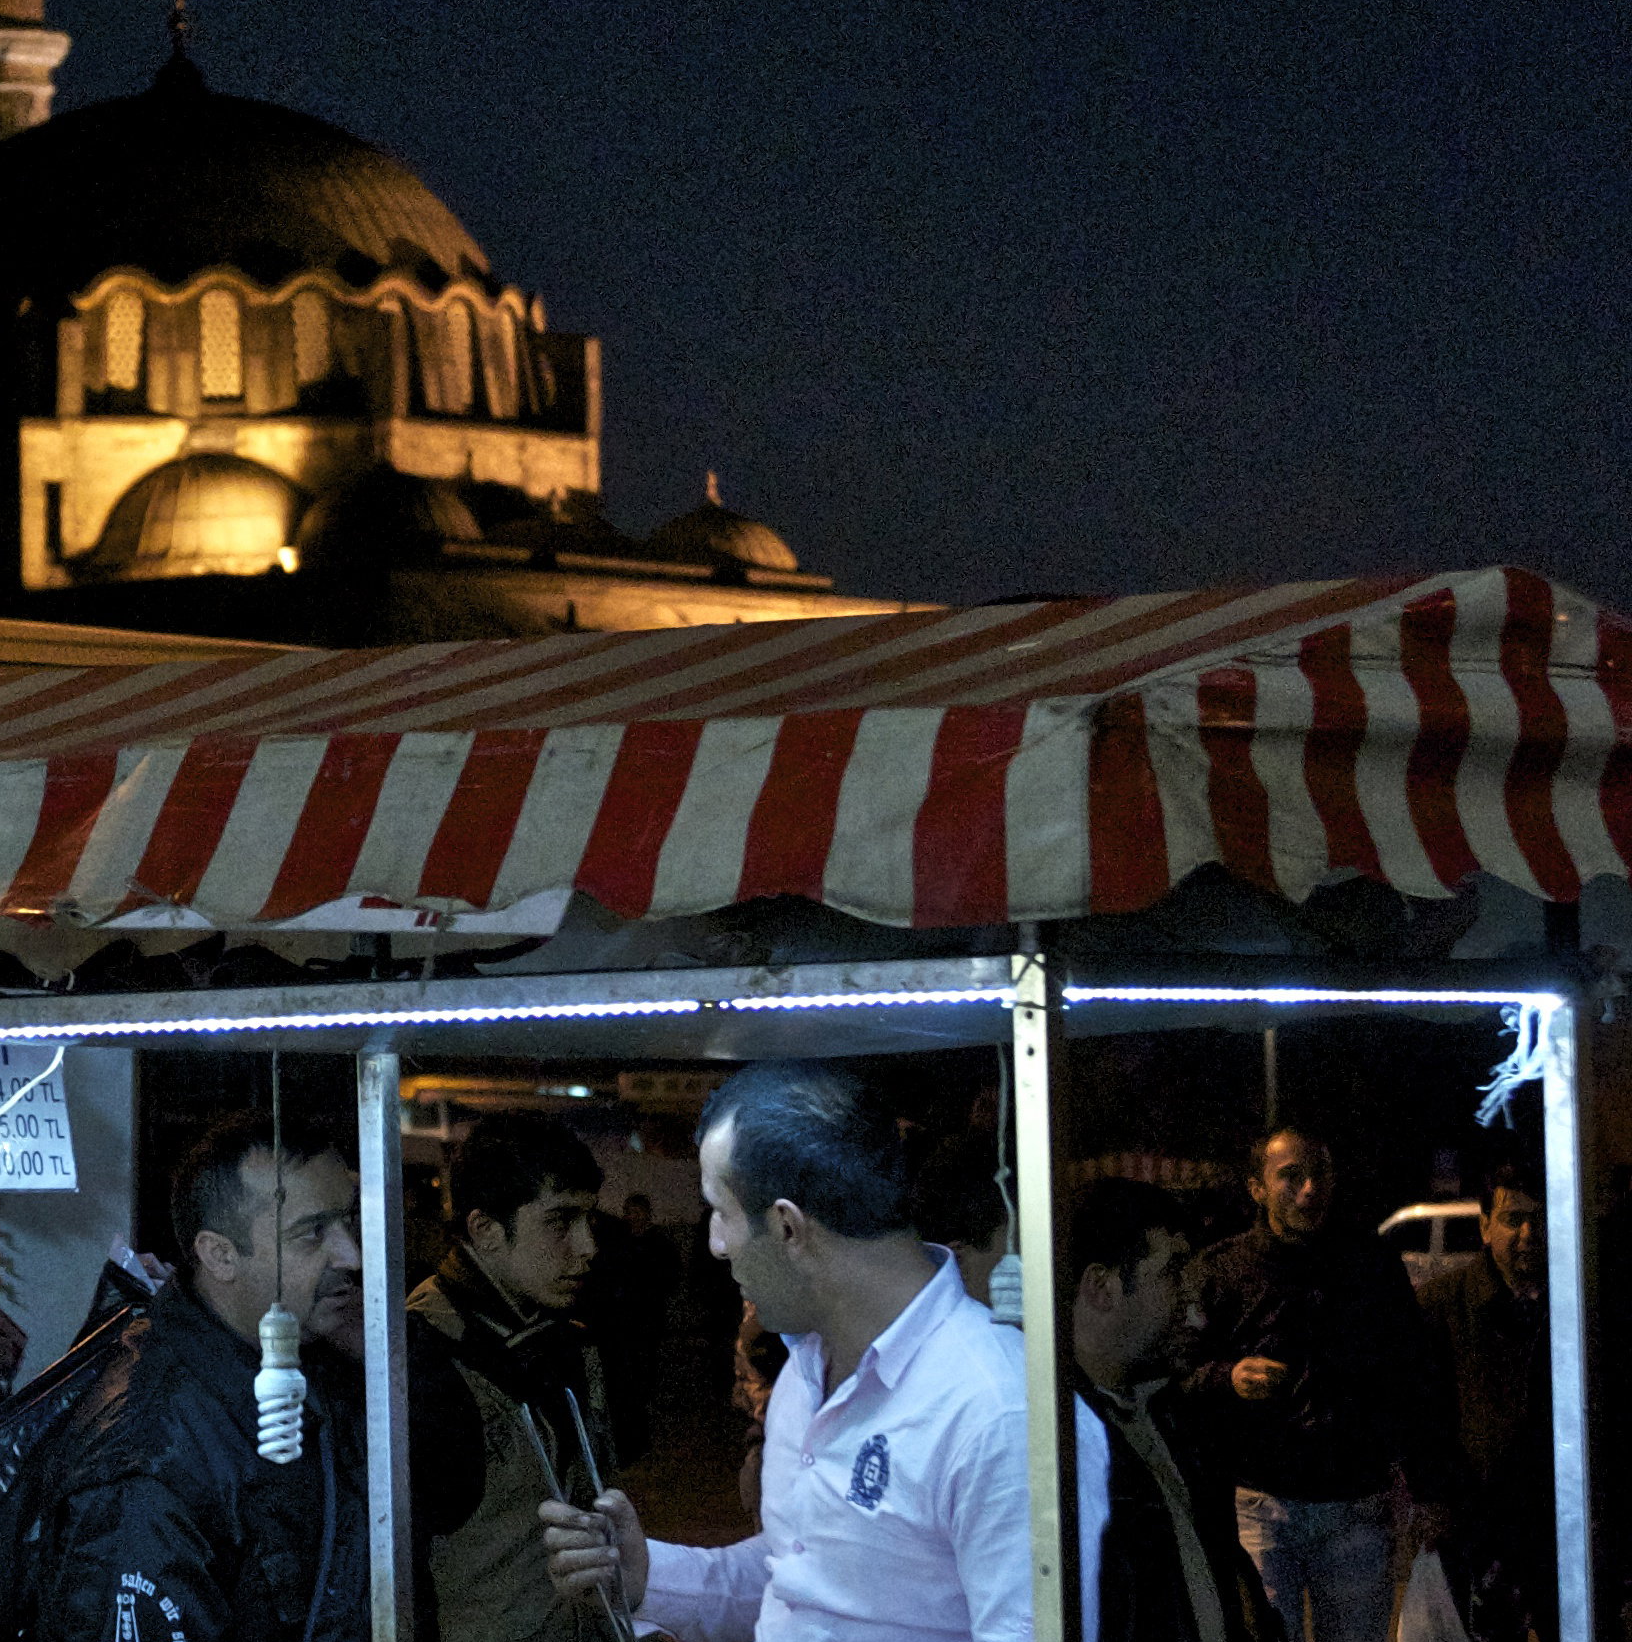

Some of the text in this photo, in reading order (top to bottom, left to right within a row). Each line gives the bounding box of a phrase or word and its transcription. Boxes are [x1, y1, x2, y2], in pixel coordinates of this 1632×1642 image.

[40, 1082, 65, 1103] TL
[0, 1114, 39, 1139] 5.00
[44, 1118, 66, 1139] TL
[49, 1155, 71, 1176] TL
